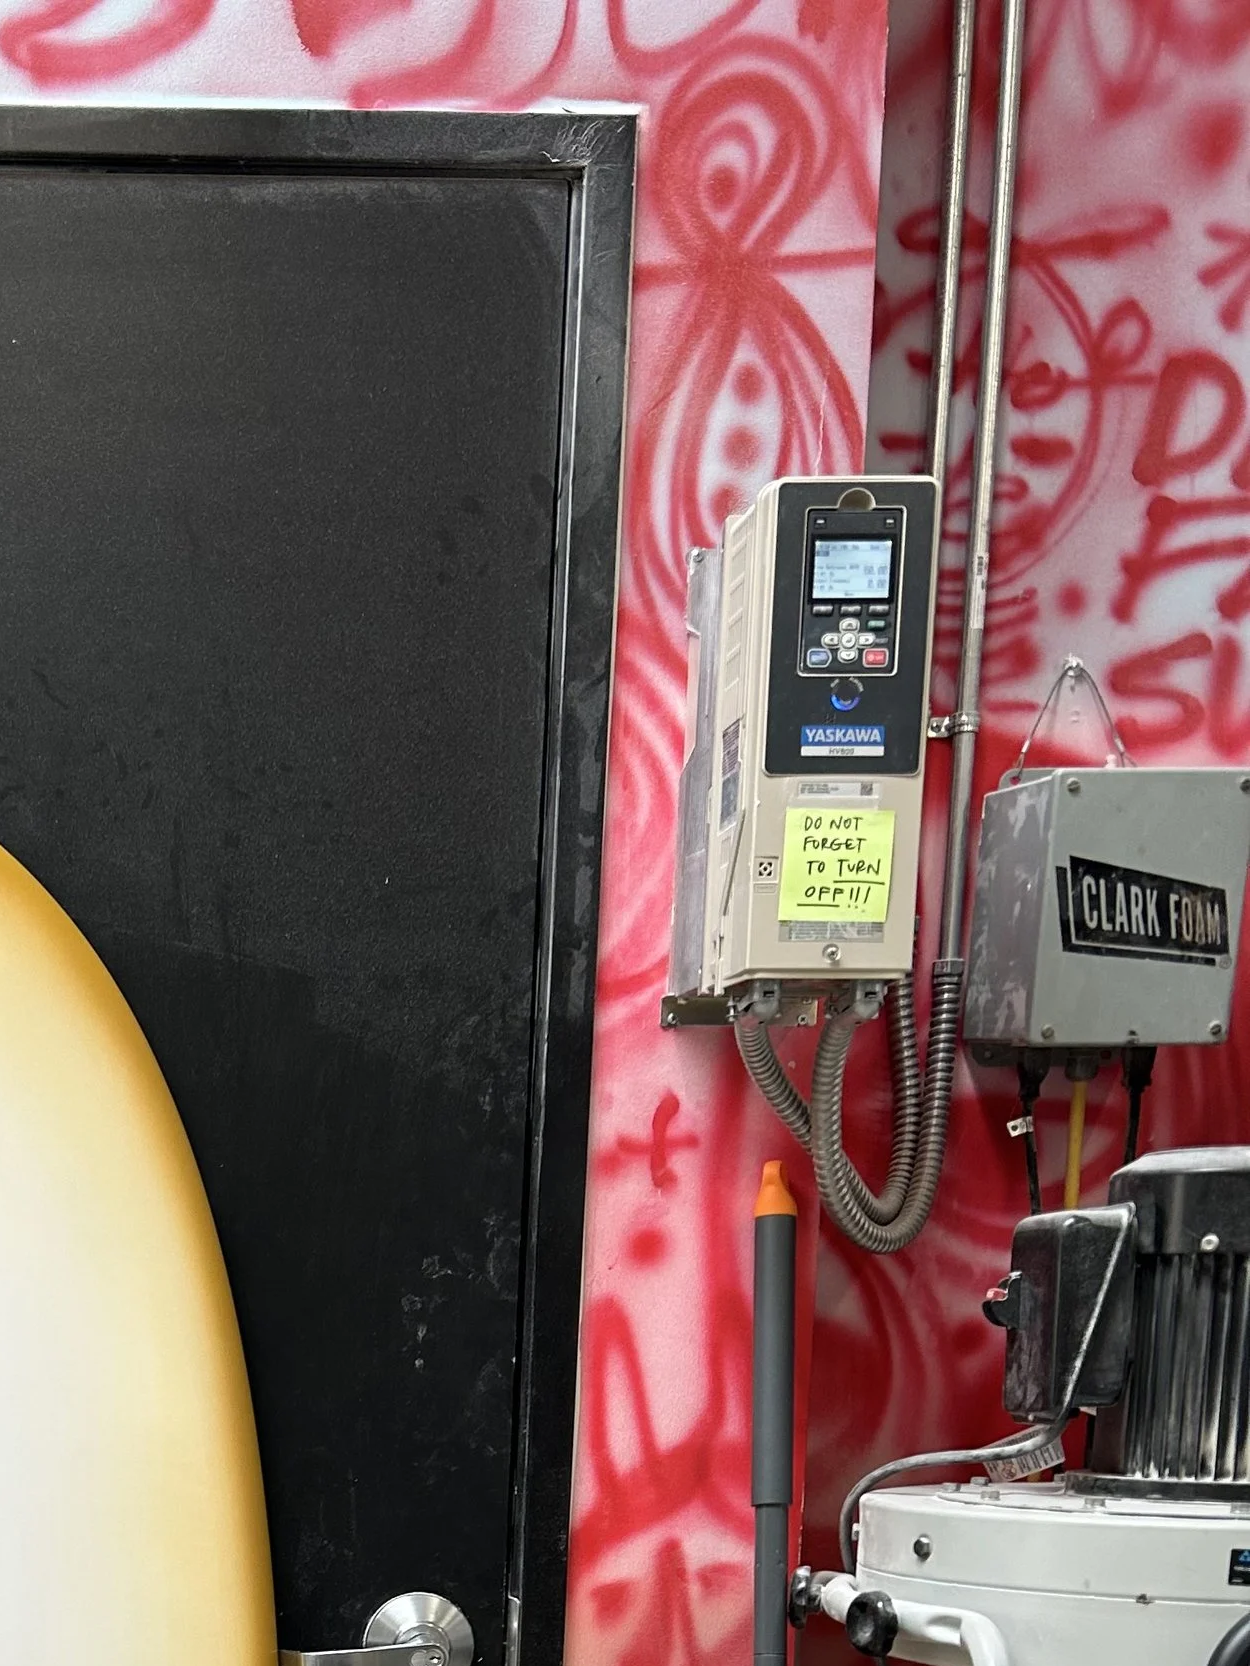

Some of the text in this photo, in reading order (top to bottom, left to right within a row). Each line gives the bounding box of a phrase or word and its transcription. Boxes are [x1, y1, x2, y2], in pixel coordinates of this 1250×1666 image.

[805, 728, 882, 743] YASKAWA
[804, 815, 864, 832] DO NOT
[803, 835, 867, 853] FORGET
[806, 858, 881, 877] TO TURN
[1082, 874, 1222, 946] CLARK FOAM
